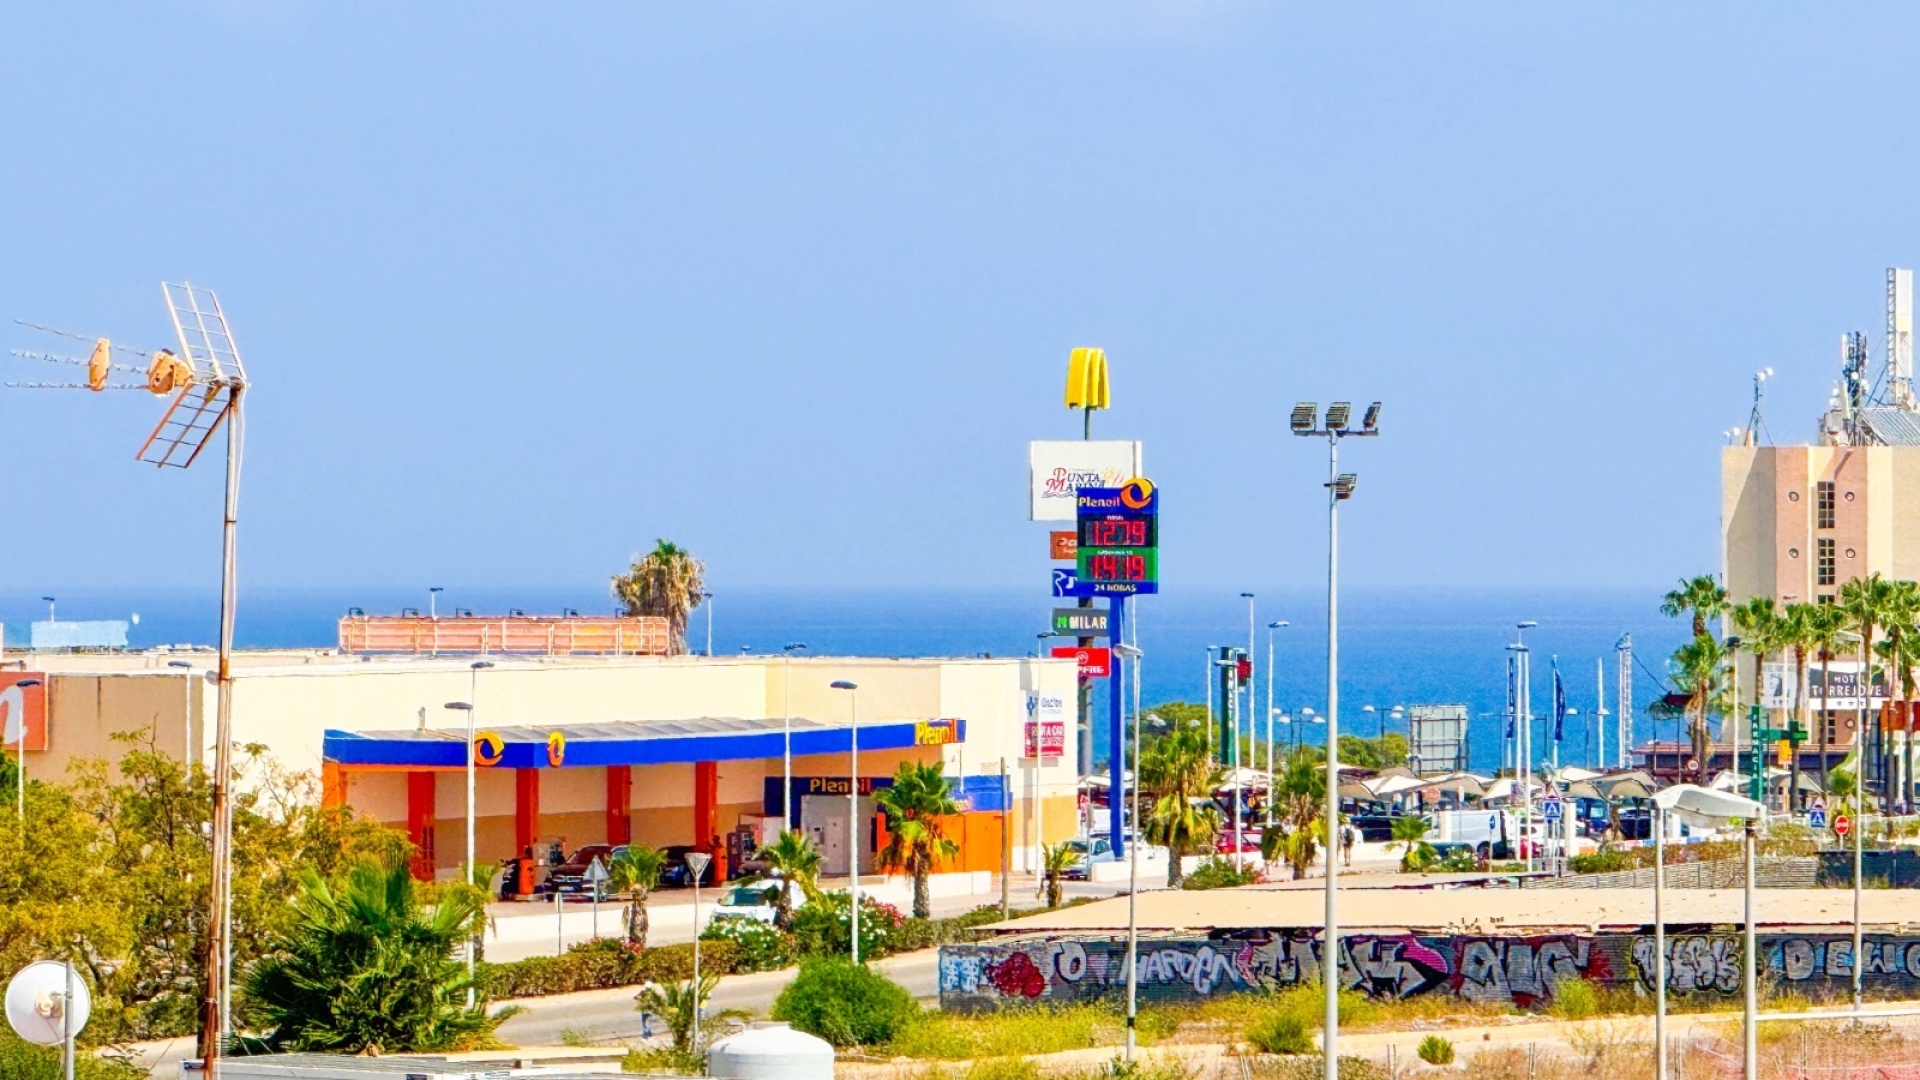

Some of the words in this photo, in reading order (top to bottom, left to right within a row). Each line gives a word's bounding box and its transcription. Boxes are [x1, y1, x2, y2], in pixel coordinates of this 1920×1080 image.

[1053, 467, 1100, 482] PUNTA
[1834, 674, 1866, 684] HOTL
[809, 777, 871, 793] Plenil
